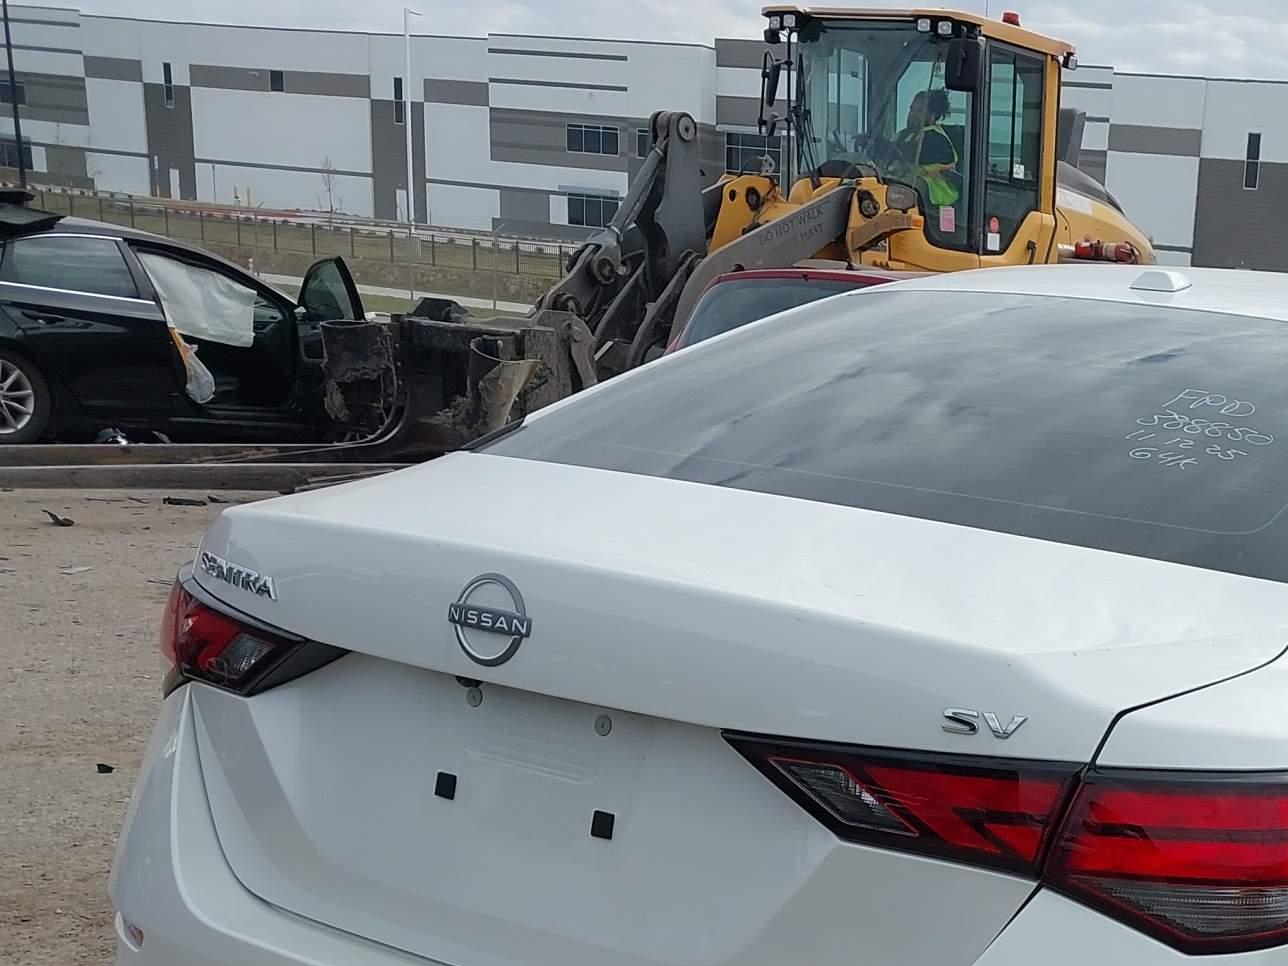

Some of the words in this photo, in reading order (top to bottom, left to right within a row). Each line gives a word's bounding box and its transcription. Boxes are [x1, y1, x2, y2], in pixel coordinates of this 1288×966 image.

[797, 207, 825, 226] WALK
[1161, 388, 1256, 418] FPD
[1125, 429, 1157, 441] 11
[1164, 437, 1195, 449] 12
[1205, 444, 1248, 460] 25
[200, 550, 278, 602] SENTRA
[448, 605, 528, 635] NISSAN
[941, 707, 1029, 740] SV
